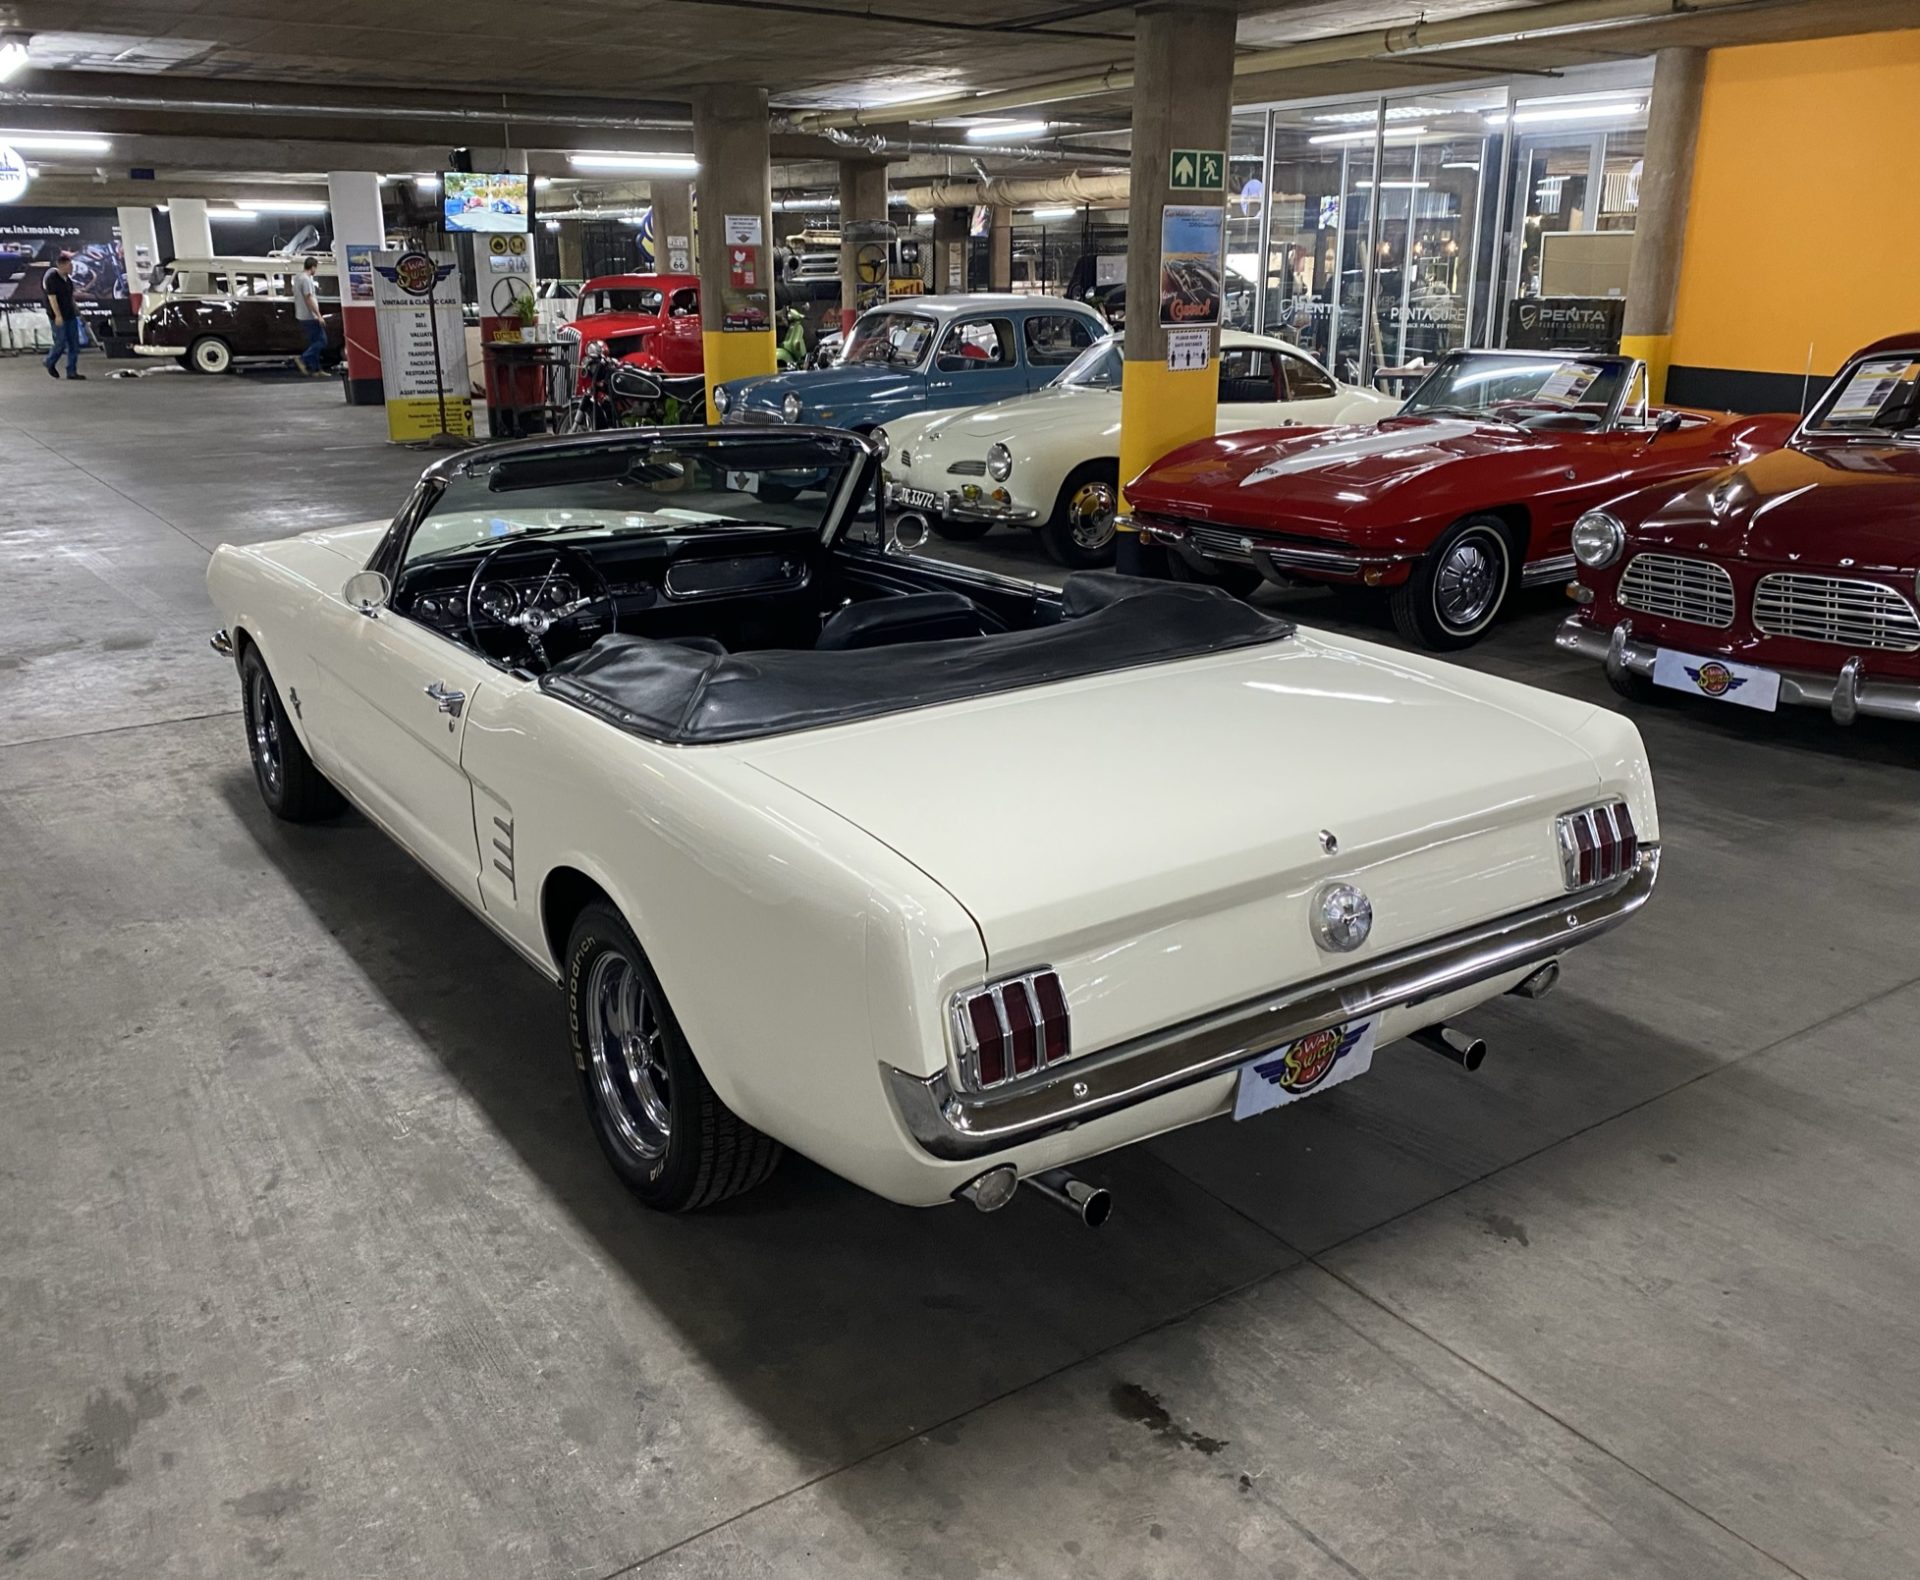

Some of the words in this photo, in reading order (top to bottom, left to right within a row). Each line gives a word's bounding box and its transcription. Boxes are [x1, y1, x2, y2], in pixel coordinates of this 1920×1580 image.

[673, 261, 685, 269] 66
[1539, 309, 1605, 322] PENTA
[1306, 1061, 1326, 1079] JY
